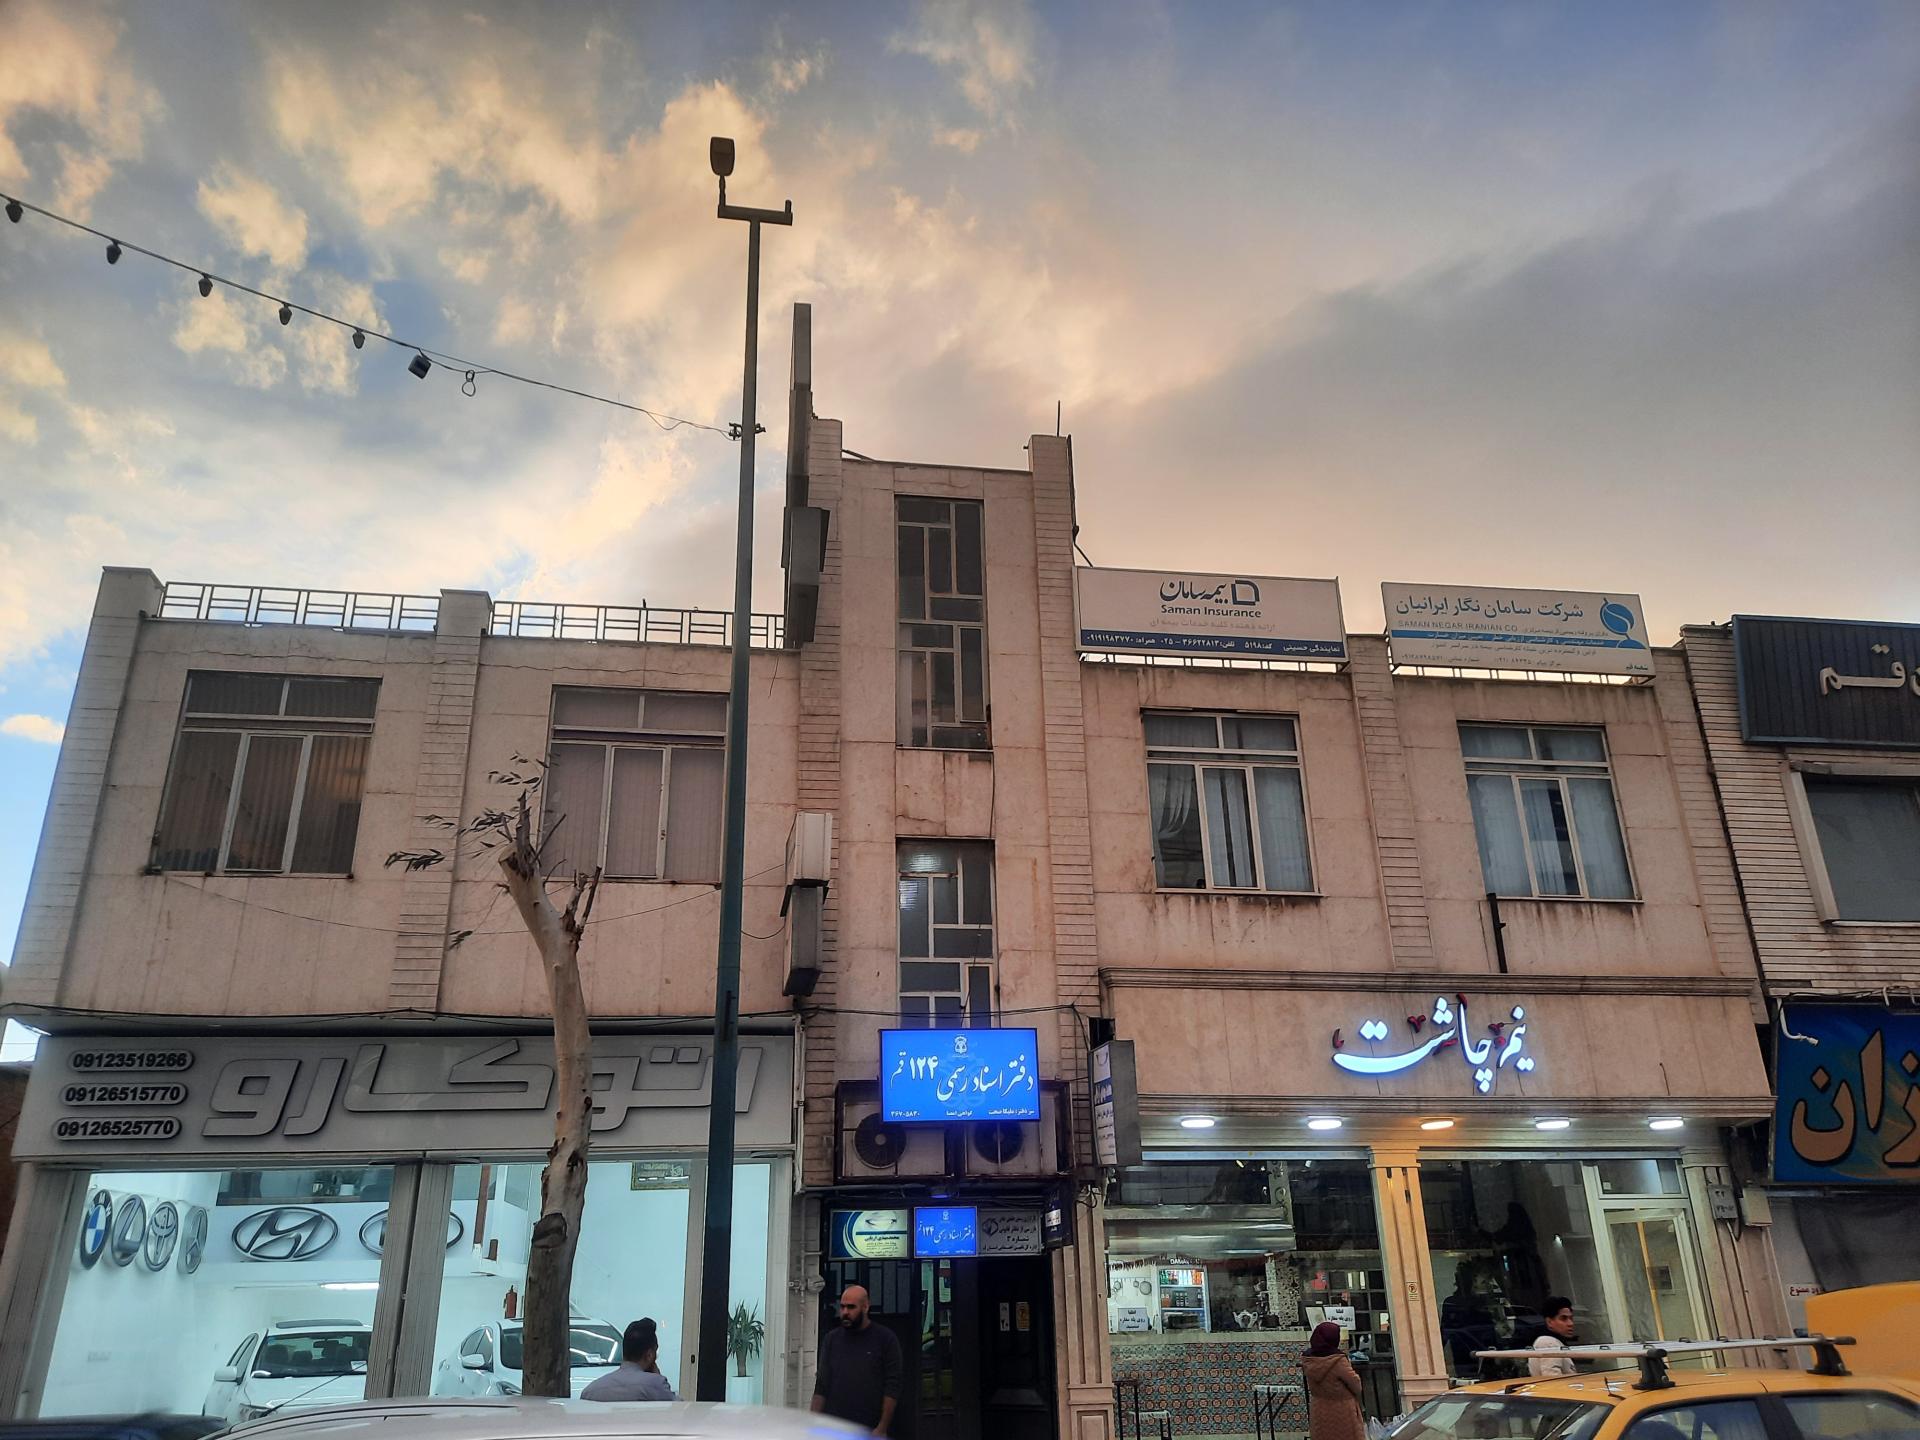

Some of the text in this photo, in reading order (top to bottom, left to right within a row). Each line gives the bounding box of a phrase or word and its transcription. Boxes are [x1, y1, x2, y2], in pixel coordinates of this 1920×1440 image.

[1160, 580, 1229, 604] بیمه سامان
[1161, 604, 1262, 618] Saman Insurance
[1396, 595, 1584, 622] شرکت سامان نگار ایرانیان
[1399, 620, 1430, 628] SAMAN
[1331, 996, 1535, 1093] نیم چاشت
[73, 1053, 187, 1068] 09123519266
[890, 1051, 1034, 1102] دفتر اسناد رسمی ۱۲۴ قم
[65, 1086, 180, 1102] 09126515770
[57, 1120, 174, 1137] 09126525770
